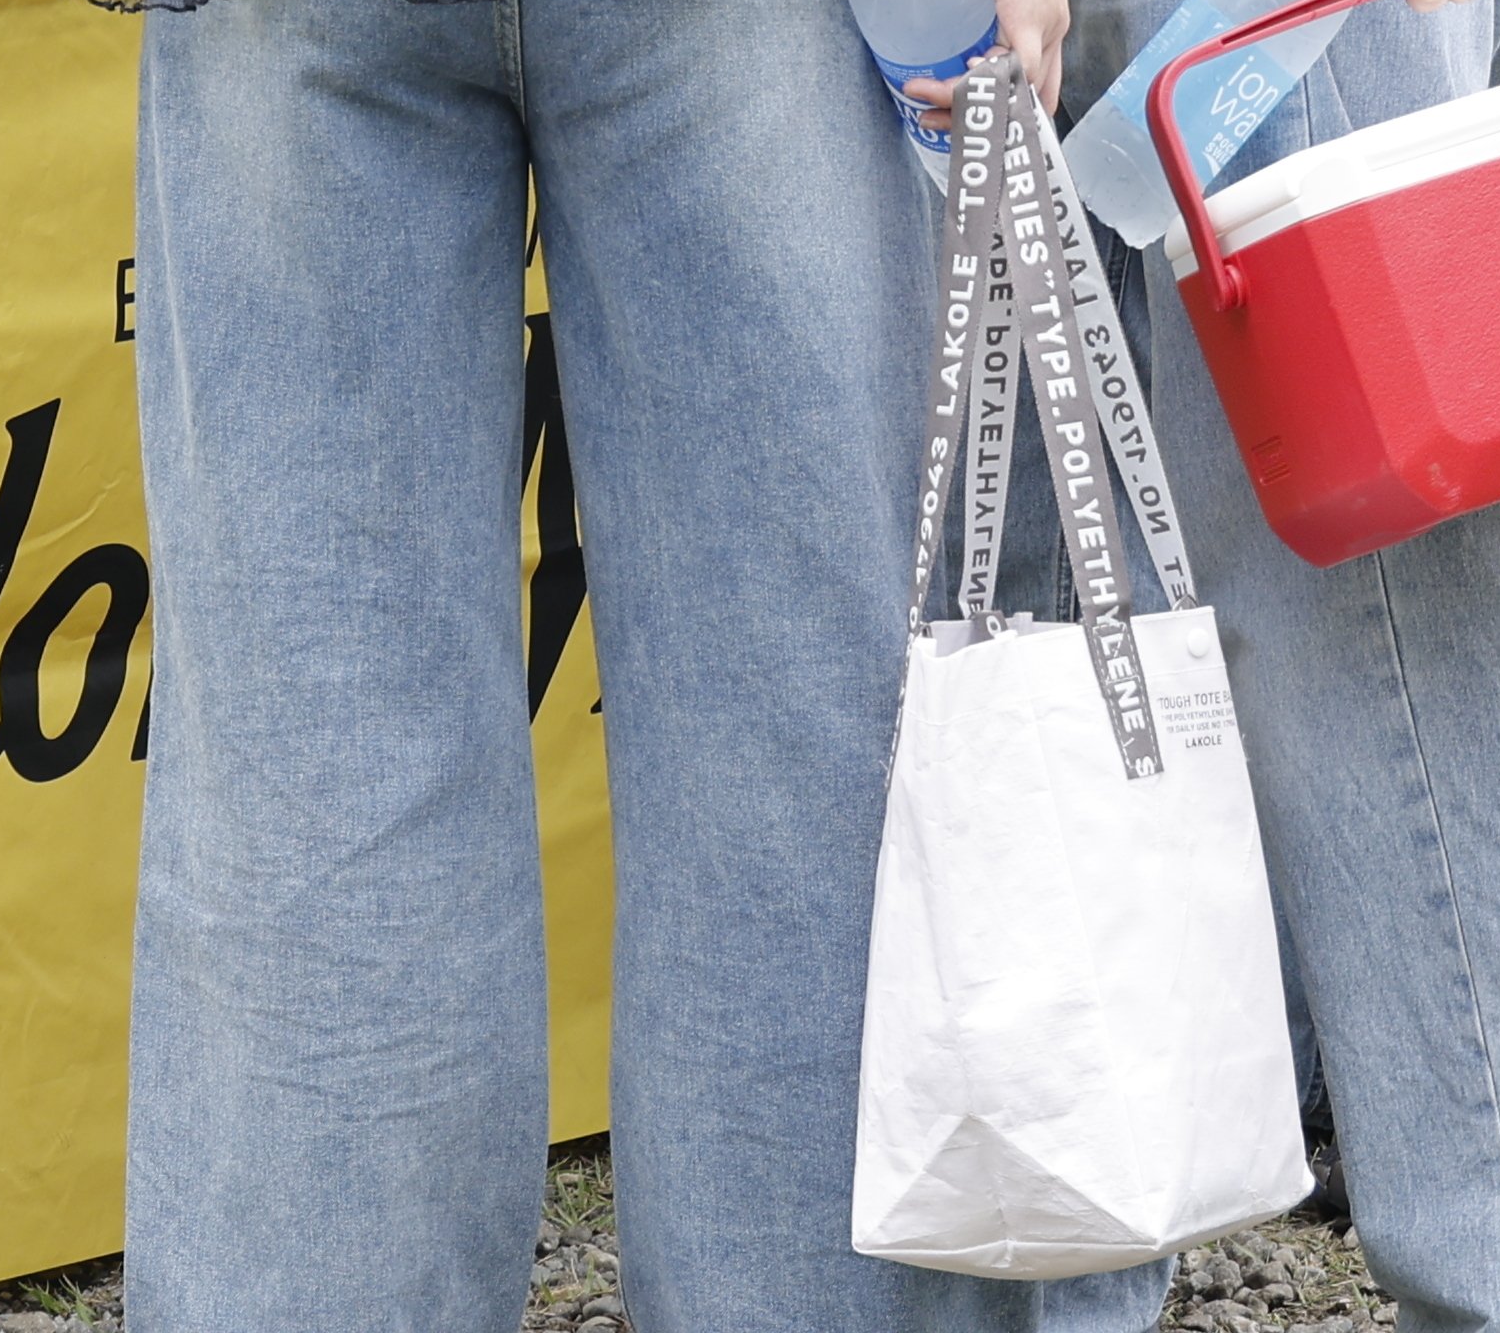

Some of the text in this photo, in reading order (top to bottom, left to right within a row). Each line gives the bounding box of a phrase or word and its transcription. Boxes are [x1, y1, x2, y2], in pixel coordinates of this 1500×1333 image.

[1228, 54, 1279, 115] ion
[936, 253, 979, 417] LAKOLE
[1194, 691, 1221, 706] TOTE
[1185, 734, 1222, 749] LAKOLE
